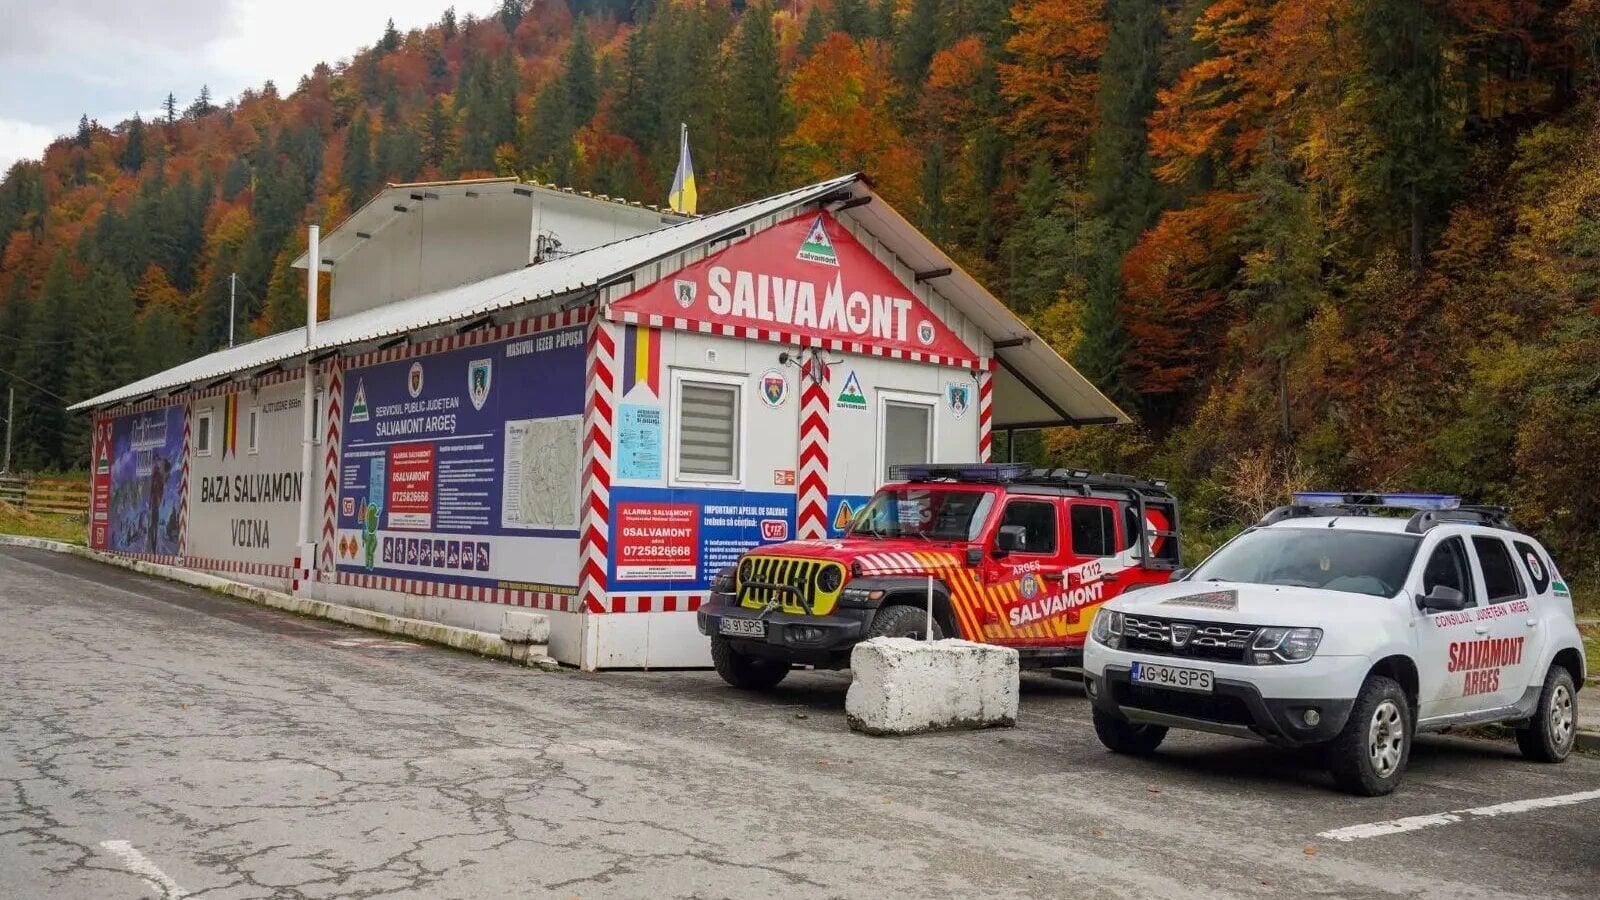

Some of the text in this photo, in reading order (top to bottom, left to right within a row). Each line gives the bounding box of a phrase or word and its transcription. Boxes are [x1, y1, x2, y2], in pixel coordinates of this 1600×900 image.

[799, 252, 837, 265] salvamont
[708, 266, 912, 342] SALVAMONT
[506, 339, 534, 357] MASIVUL
[536, 336, 554, 352] IEZER
[375, 403, 403, 417] SERVICIUL
[404, 400, 425, 413] PUBLIC
[836, 402, 868, 411] salvamont
[376, 418, 424, 436] SALVAMONT
[201, 471, 303, 502] BAZA SALVAMON
[739, 506, 758, 516] APELUL
[758, 507, 766, 516] DE
[766, 507, 788, 516] SALVARE
[231, 518, 270, 548] VOINA
[623, 527, 692, 537] 0SALVAMONT
[770, 524, 782, 533] 112
[623, 545, 691, 557] 0725826668
[1087, 562, 1101, 577] 112
[1009, 581, 1104, 626] SALVAMONT
[733, 619, 741, 631] 91
[743, 620, 762, 632] SPS
[1435, 613, 1473, 628] CONSILIUL
[1448, 636, 1524, 672] SALVAMONT
[1140, 666, 1209, 688] AG 94 SPS
